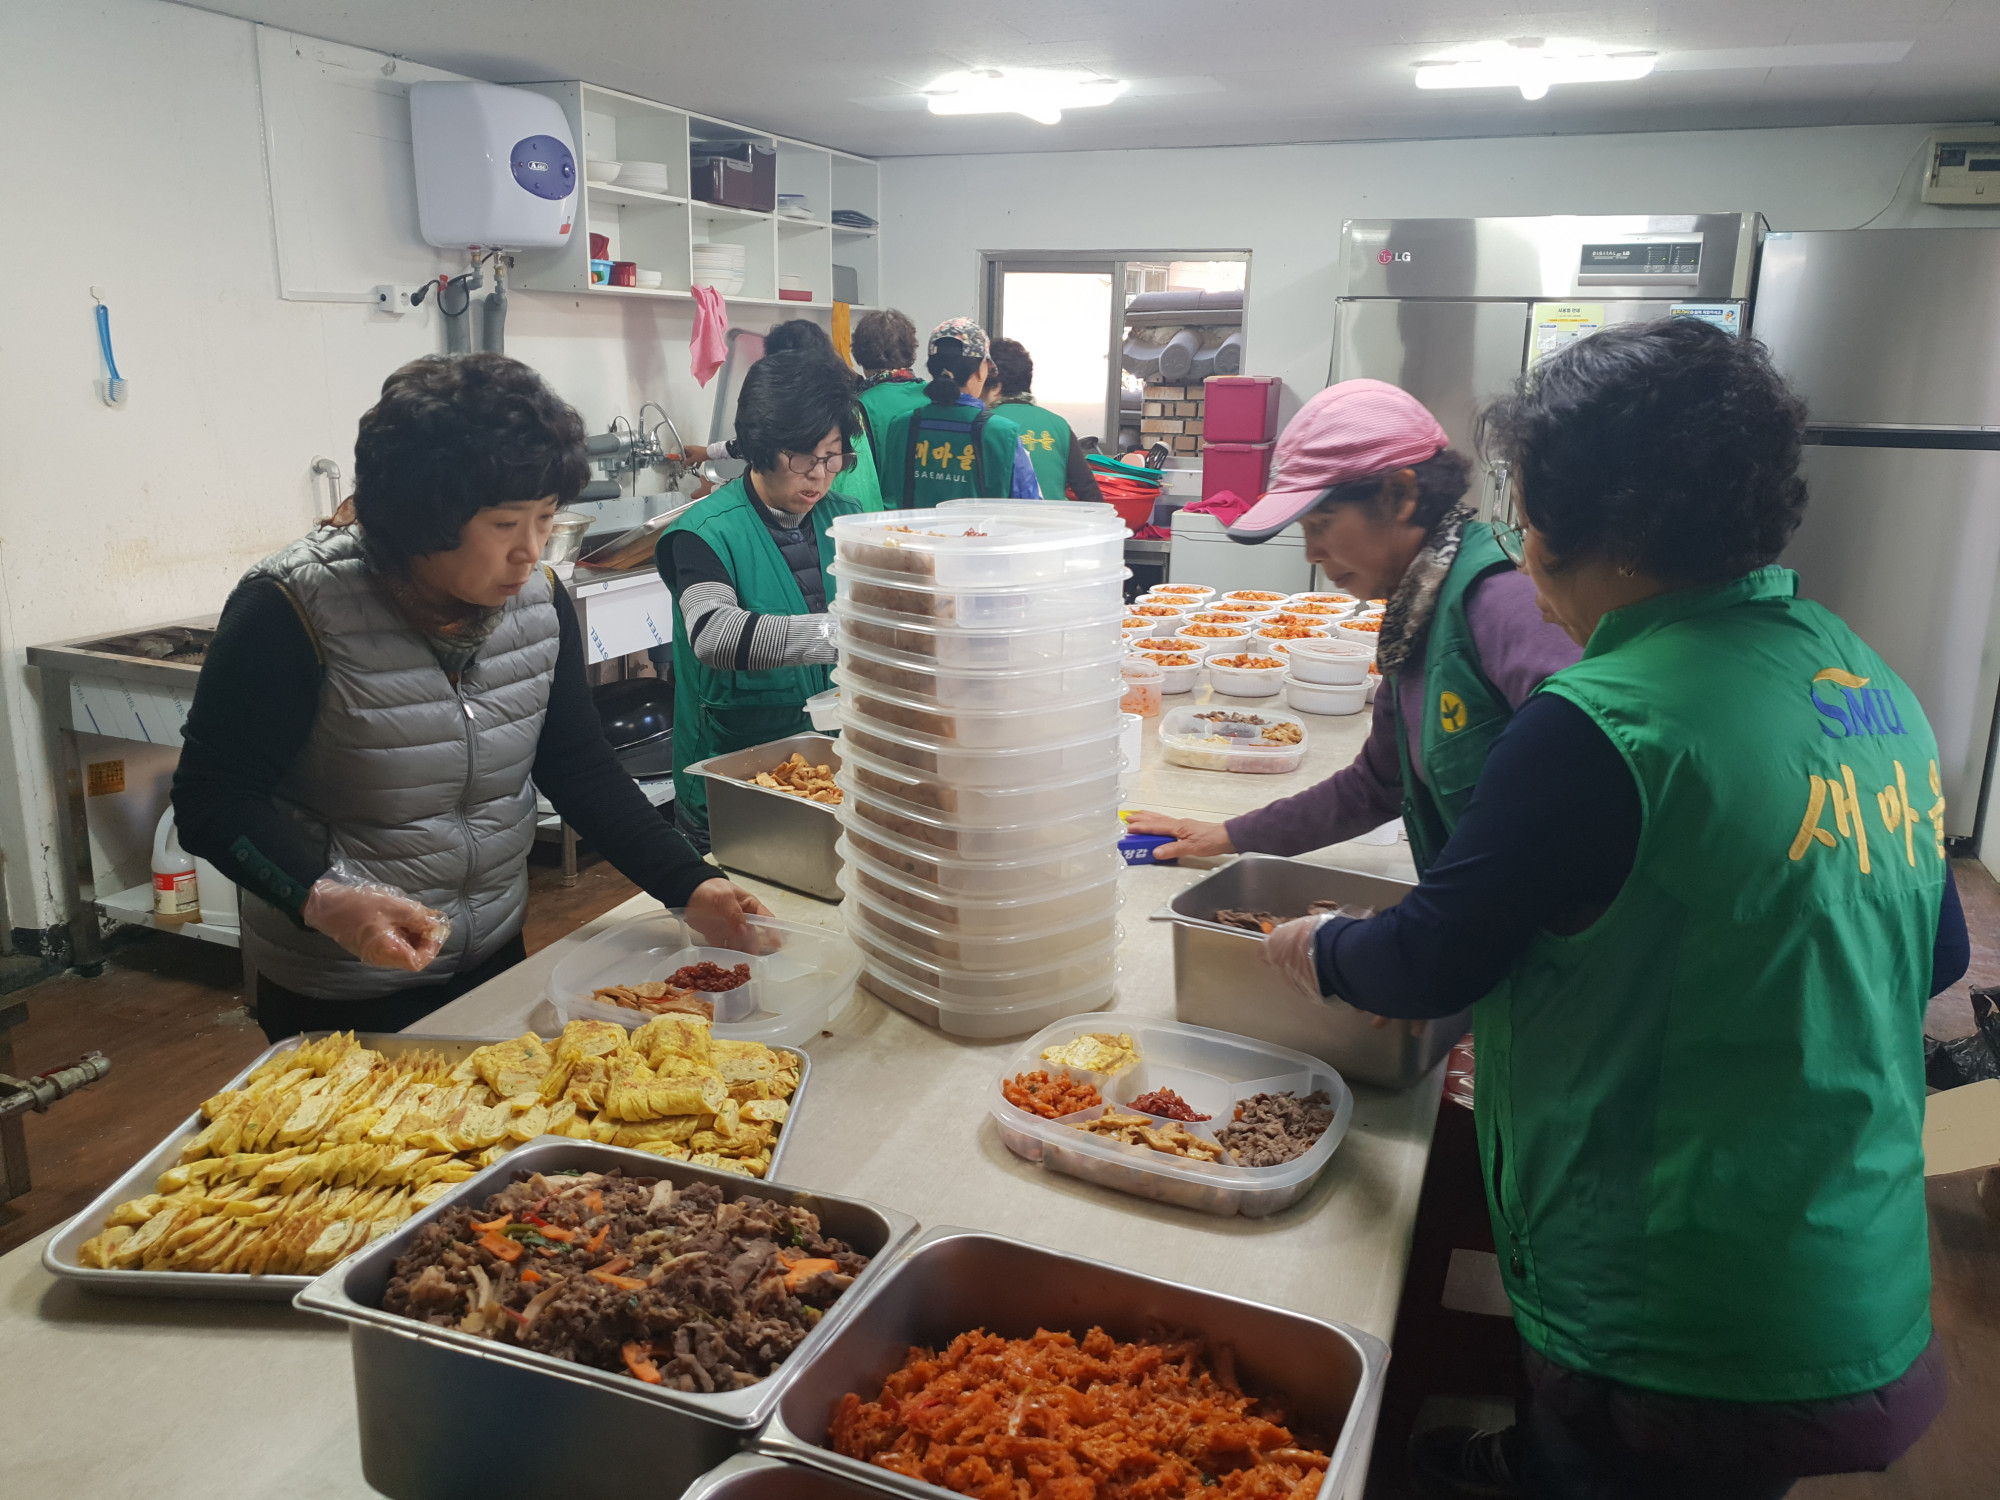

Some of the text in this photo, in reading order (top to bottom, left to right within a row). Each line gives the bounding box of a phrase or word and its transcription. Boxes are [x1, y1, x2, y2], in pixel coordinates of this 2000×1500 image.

[1394, 251, 1411, 262] LG
[914, 470, 967, 483] SAEMAUL
[590, 625, 609, 660] STEEL
[645, 611, 663, 646] STEEL
[121, 687, 136, 711] STEEL
[1811, 667, 1909, 739] SMU
